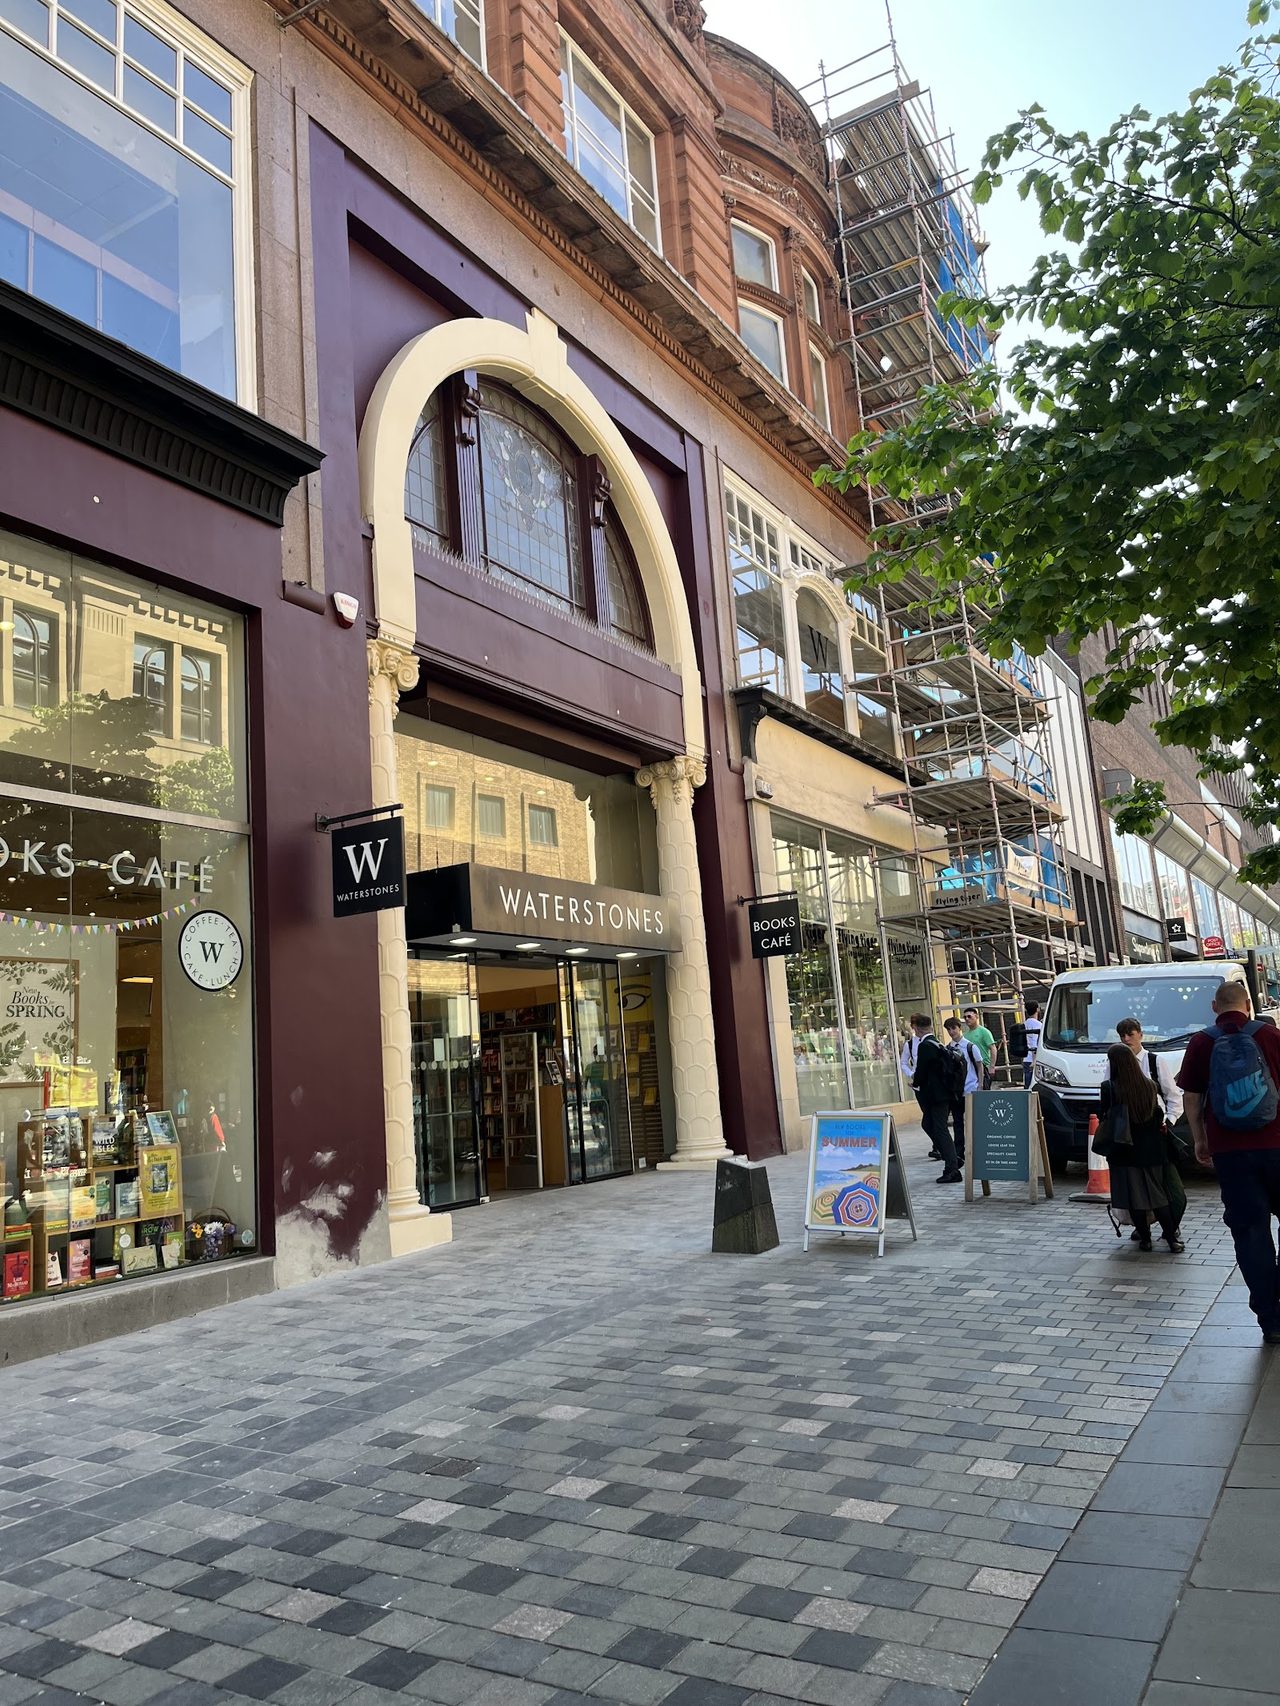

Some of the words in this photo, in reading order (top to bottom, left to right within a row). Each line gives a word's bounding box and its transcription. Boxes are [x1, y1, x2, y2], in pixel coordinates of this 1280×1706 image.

[806, 625, 829, 668] W
[0, 836, 75, 878] KS
[111, 853, 214, 894] CAFÉ
[342, 838, 389, 884] W
[336, 883, 400, 902] WATERSTONES
[936, 894, 959, 905] flying
[499, 886, 664, 935] WATERSTONES
[185, 916, 219, 942] COFFEE
[225, 925, 238, 946] TEA
[753, 916, 796, 932] BOOKS
[199, 940, 224, 963] W
[760, 933, 792, 949] CAFÉ
[184, 953, 204, 981] CAKE
[210, 957, 240, 986] LUNCH
[12, 991, 49, 1004] Books
[6, 1004, 65, 1018] SPRING
[1226, 1070, 1265, 1106] NIKE
[821, 1136, 877, 1148] SUMMER
